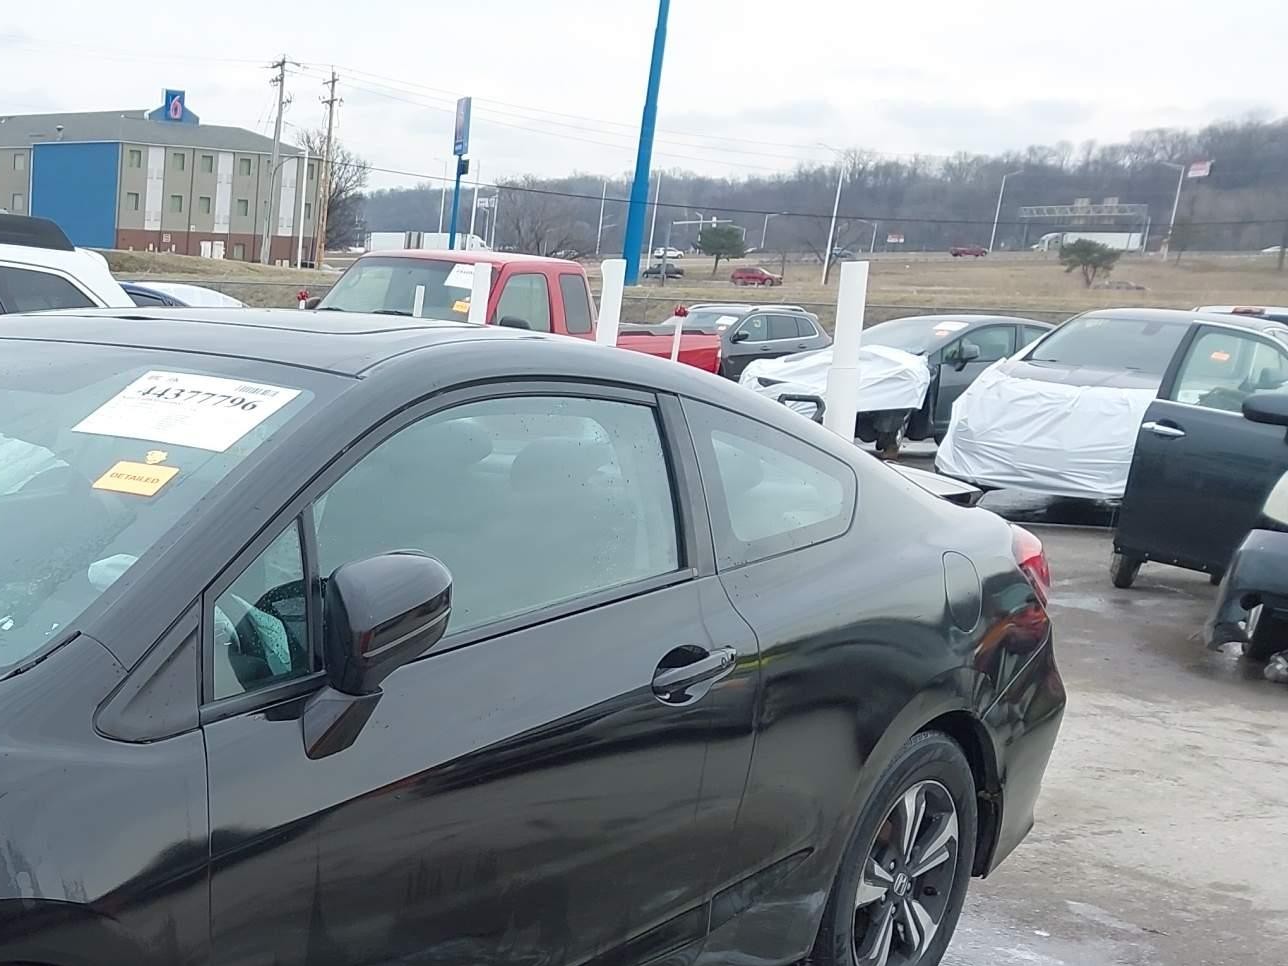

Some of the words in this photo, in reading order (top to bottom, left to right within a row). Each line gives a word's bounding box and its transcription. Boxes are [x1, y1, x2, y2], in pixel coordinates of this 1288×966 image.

[170, 95, 183, 120] 6
[137, 385, 261, 412] 44377796
[109, 471, 160, 485] DETAILED
